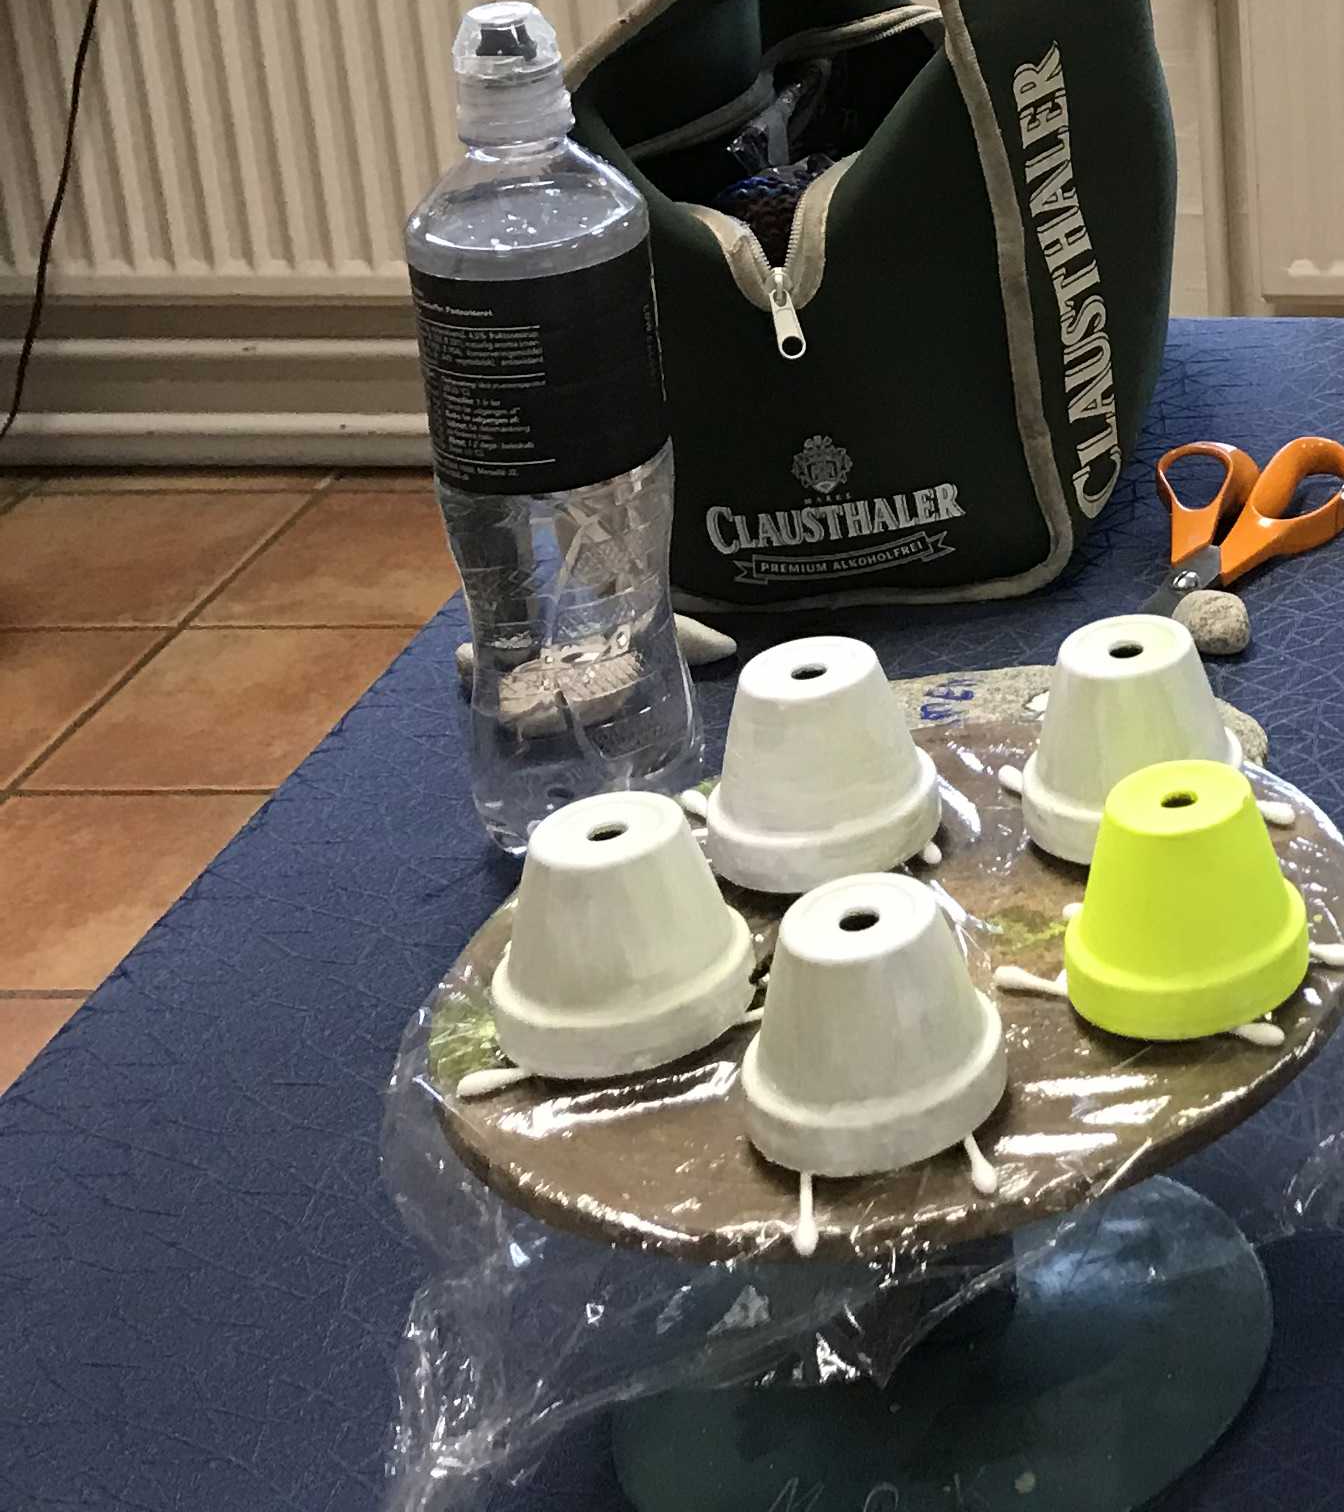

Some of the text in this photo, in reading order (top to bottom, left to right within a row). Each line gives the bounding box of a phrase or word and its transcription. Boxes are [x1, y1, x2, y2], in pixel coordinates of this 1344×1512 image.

[1012, 39, 1122, 519] CLAUSTHALER
[705, 482, 967, 555] CLAUSTHALER
[760, 540, 925, 574] PREMIUM ALKOHOLFREI
